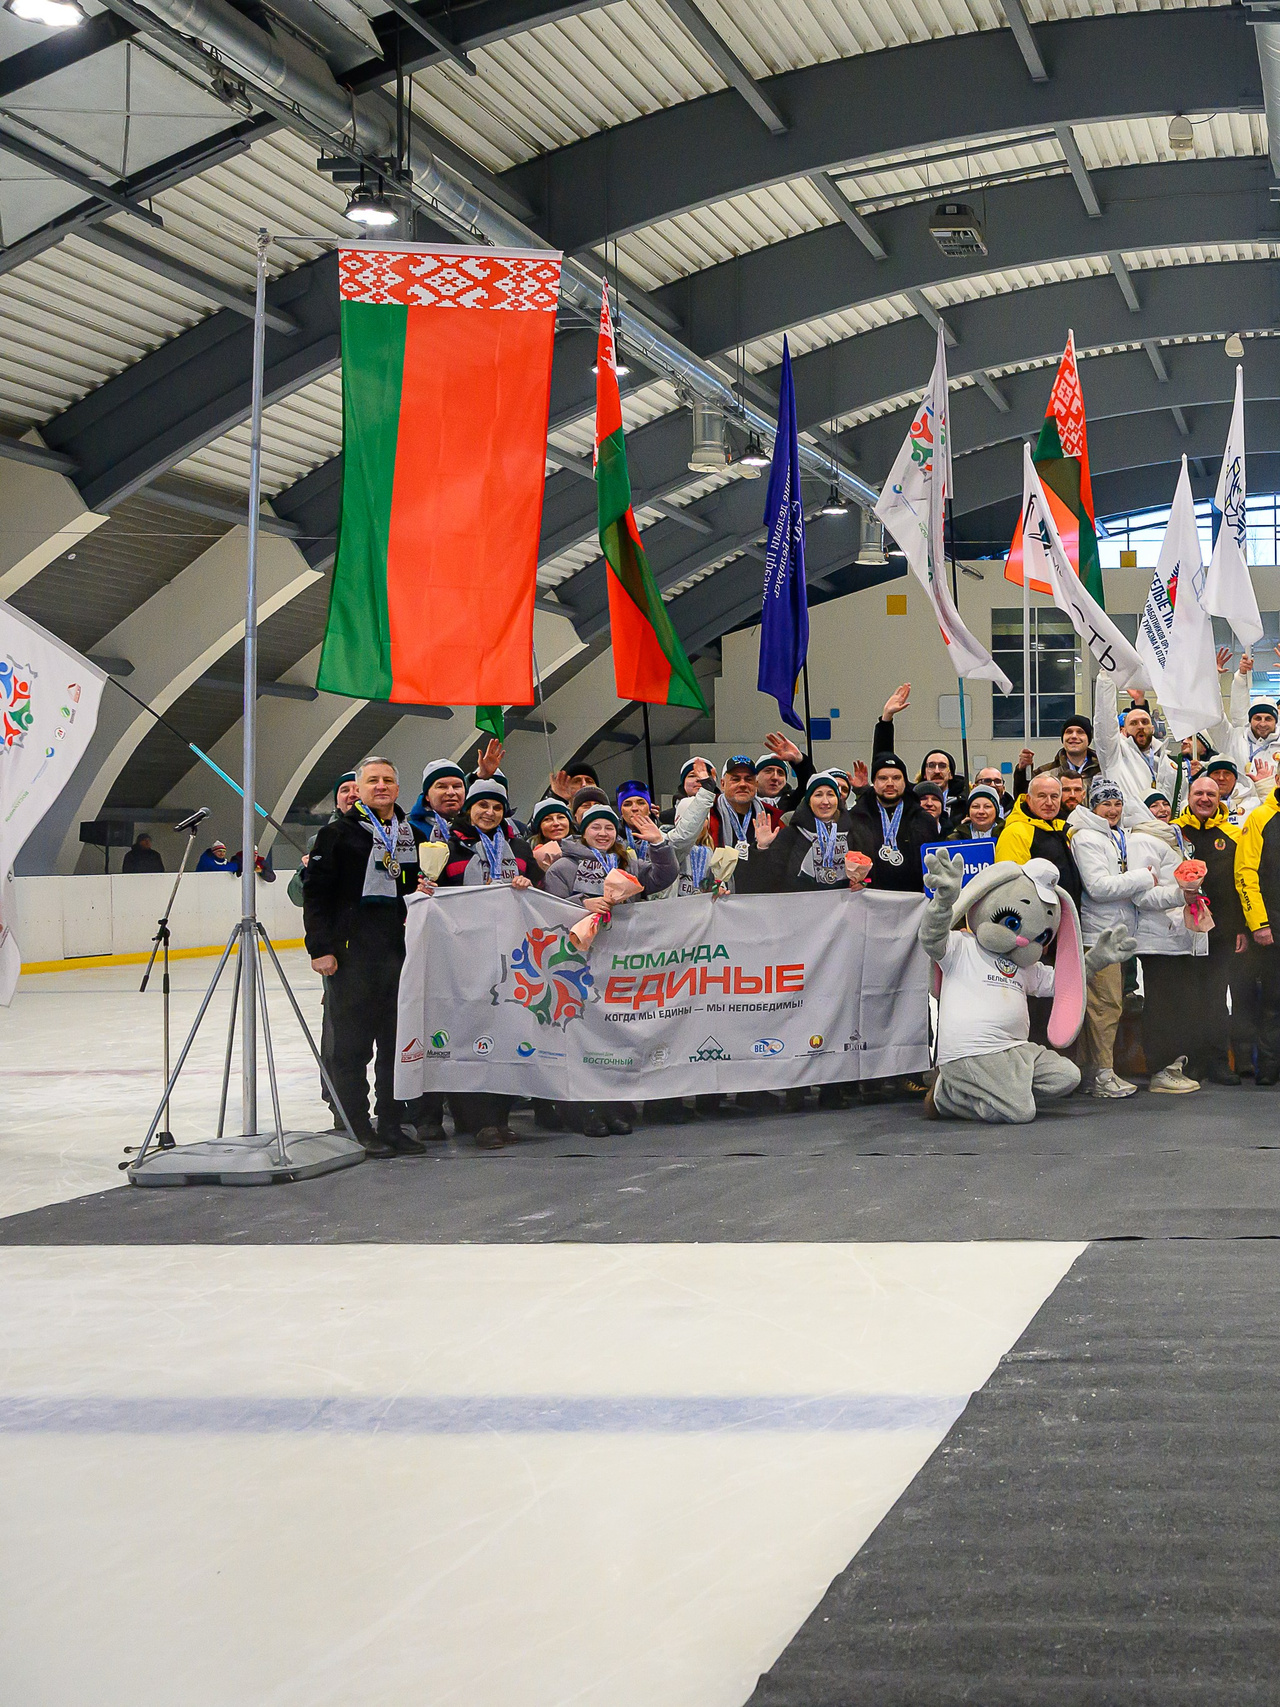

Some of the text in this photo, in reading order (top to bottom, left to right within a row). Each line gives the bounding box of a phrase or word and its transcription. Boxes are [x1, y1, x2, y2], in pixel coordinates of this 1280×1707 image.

[1142, 620, 1158, 646] ТУРИЗМА
[1145, 604, 1165, 640] РАБОТНИКОВ
[611, 944, 730, 970] КОМАНДА
[604, 963, 805, 1011] ЕДИНЫЕ
[604, 1012, 636, 1023] КОГДА
[638, 1012, 656, 1021] МЫ
[659, 1006, 692, 1020] ЕДИНЫ
[706, 1004, 725, 1012] МЫ
[728, 1000, 804, 1012] НЕПОБЕДИМЫ!
[582, 1056, 633, 1066] ВОСТОЧНЫЙ
